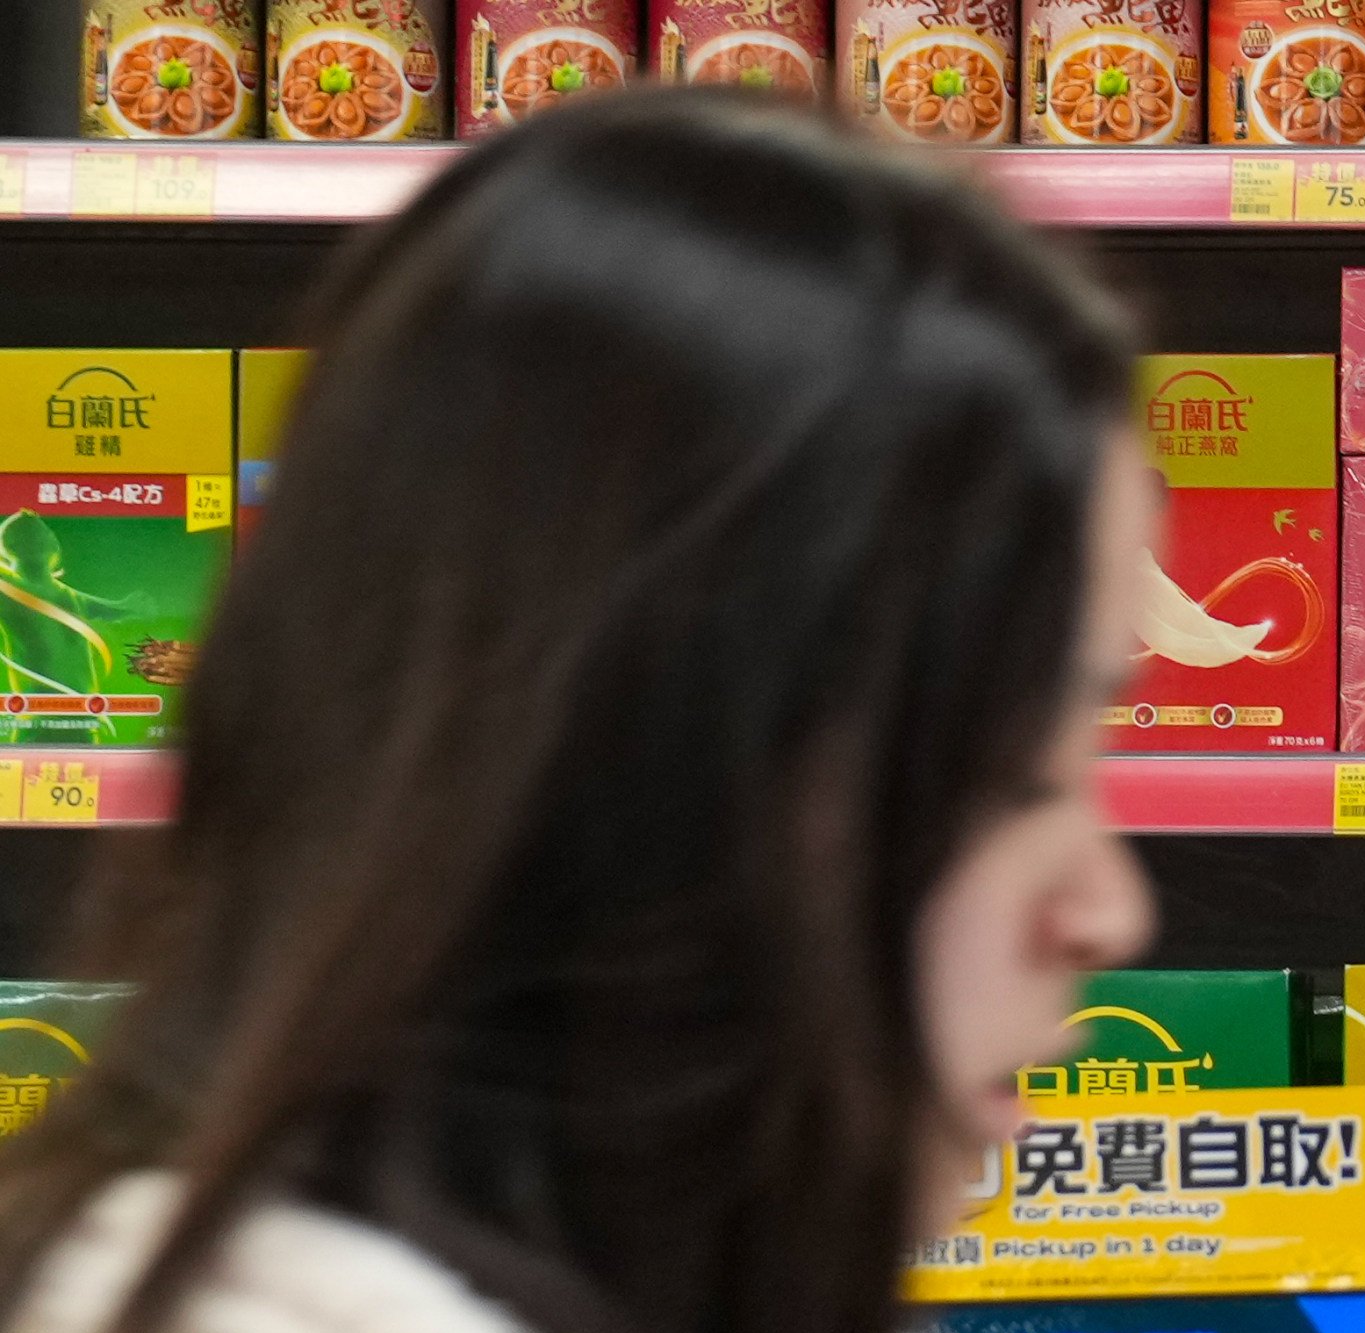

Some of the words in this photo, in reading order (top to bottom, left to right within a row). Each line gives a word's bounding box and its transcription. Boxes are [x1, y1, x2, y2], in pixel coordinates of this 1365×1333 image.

[1325, 186, 1365, 207] 75.0
[46, 394, 151, 430] 白蘭氏
[1147, 398, 1248, 432] 白蘭氏
[1156, 435, 1238, 457] 純正燕窩
[1015, 1117, 1358, 1197] 免費自取!
[1012, 1205, 1049, 1221] for
[1061, 1204, 1122, 1219] Free
[1129, 1200, 1220, 1219] Pickup
[992, 1240, 1096, 1258] Pickup
[1106, 1237, 1132, 1254] in
[1142, 1238, 1154, 1253] 1
[1166, 1237, 1220, 1258] day
